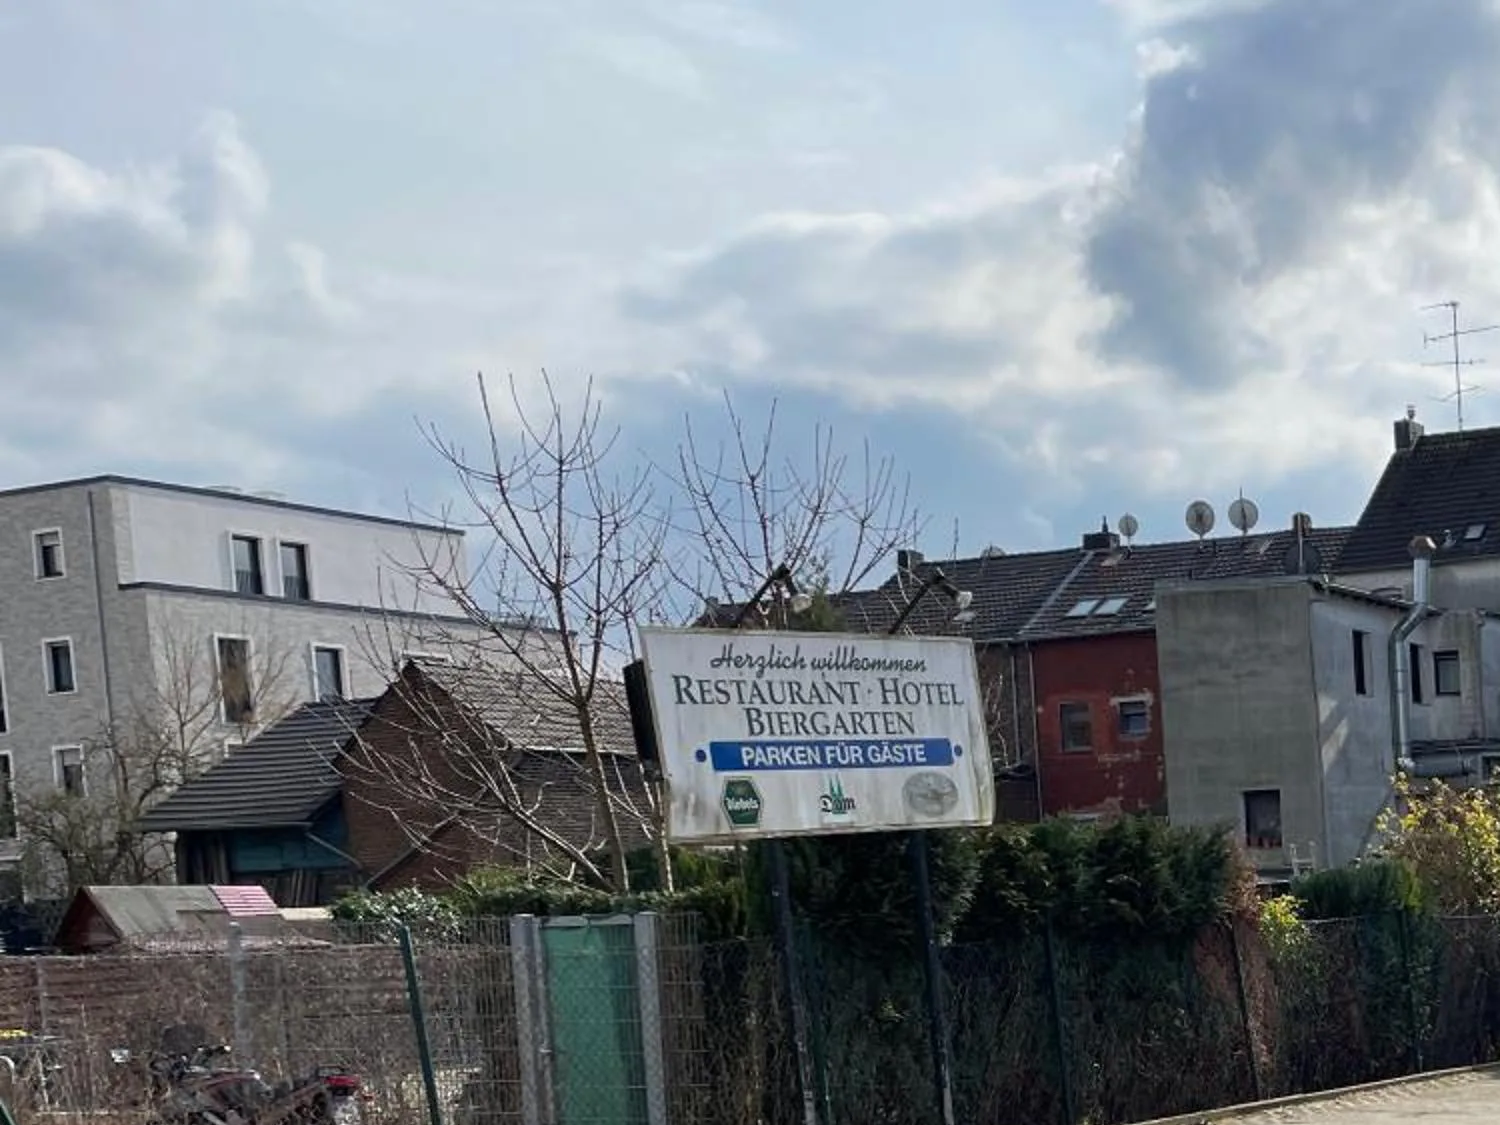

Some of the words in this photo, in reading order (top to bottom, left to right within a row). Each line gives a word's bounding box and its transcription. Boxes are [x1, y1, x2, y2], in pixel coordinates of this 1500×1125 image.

[710, 642, 806, 678] Herzlich
[810, 644, 927, 672] willkommen
[672, 674, 860, 705] RESTAURANT
[878, 677, 965, 705] HOTEL
[742, 707, 915, 736] BIERGARTEN
[741, 745, 821, 767] PARKEN
[825, 742, 864, 765] FÜR
[867, 742, 928, 763] GÄSTE
